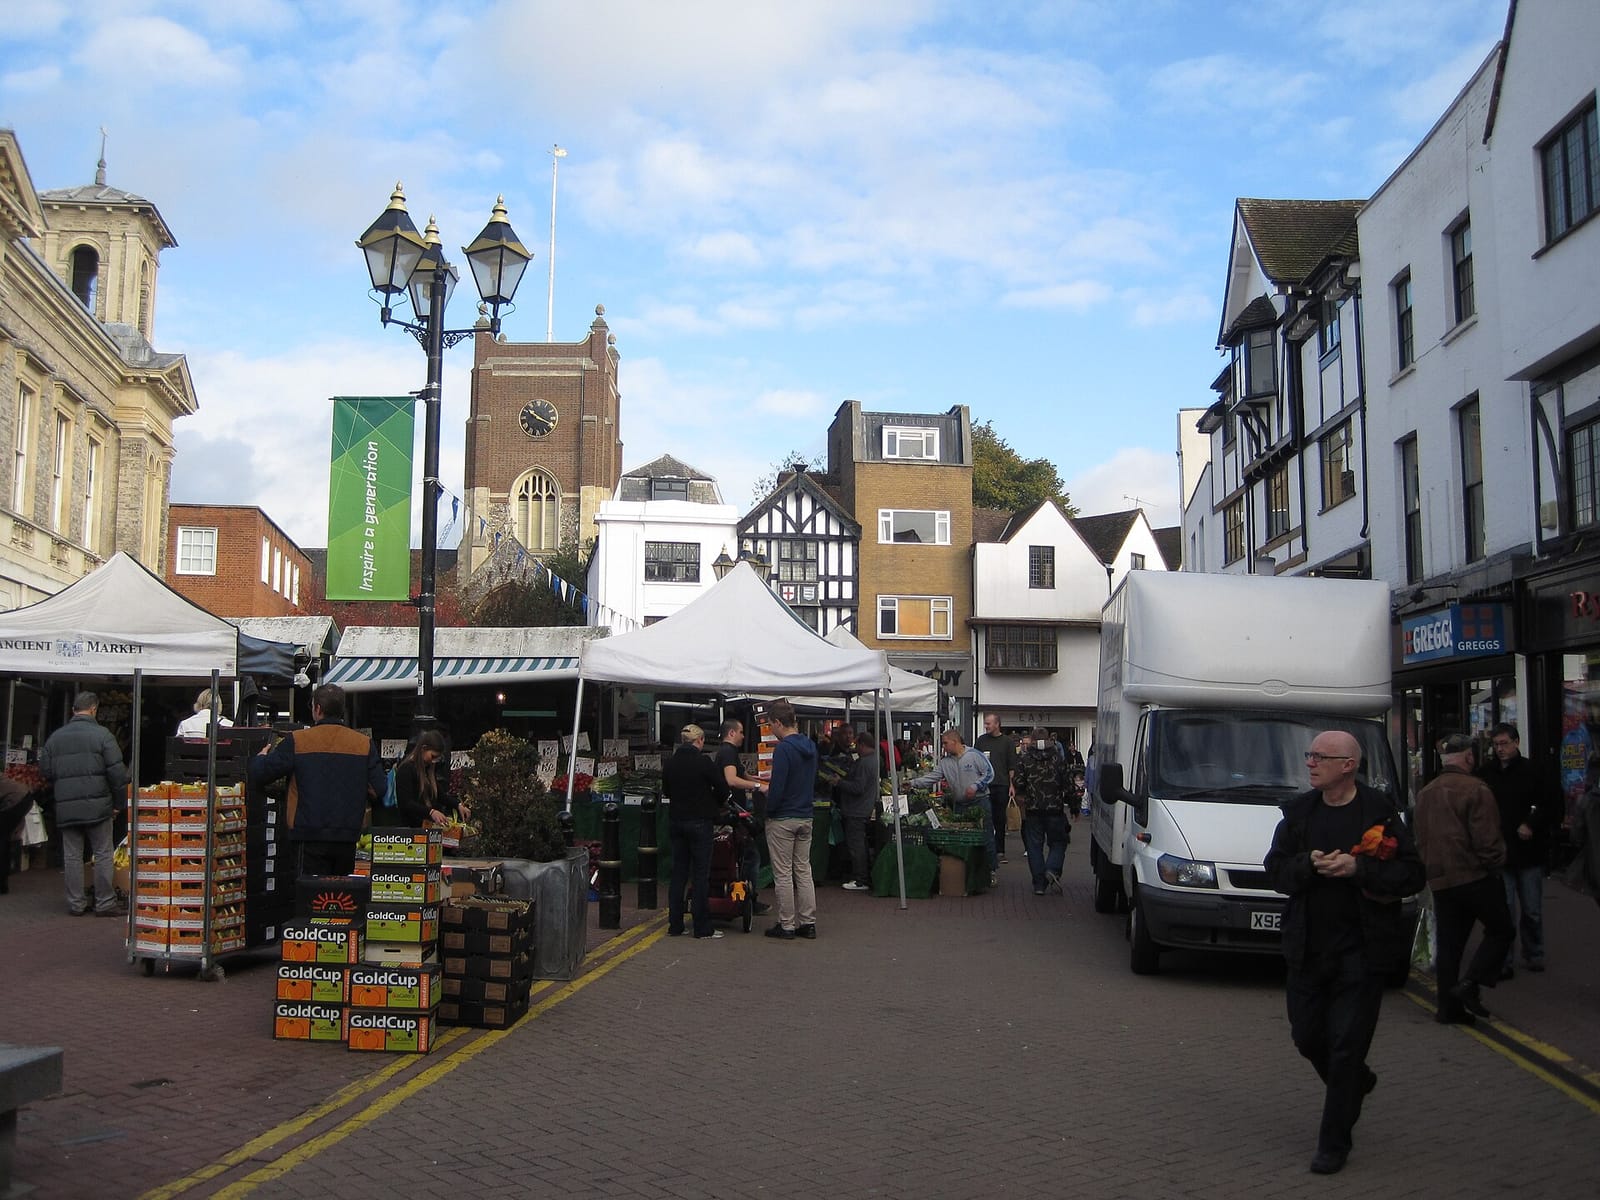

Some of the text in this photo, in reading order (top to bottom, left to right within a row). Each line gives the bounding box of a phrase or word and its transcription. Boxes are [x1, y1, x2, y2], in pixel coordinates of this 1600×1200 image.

[359, 440, 379, 592] Inspire a generation
[87, 641, 144, 654] MARKET
[1457, 640, 1500, 651] GREGGS
[1018, 712, 1051, 722] EAST
[373, 835, 412, 845] GoldCup
[371, 874, 410, 884] GoldCup
[367, 911, 406, 922] GoldCup
[283, 927, 347, 944] GoldCup
[278, 966, 342, 983] GoldCup
[352, 972, 418, 988] GoldCup
[276, 1004, 340, 1021] GoldCup
[350, 1015, 417, 1032] GoldCup
